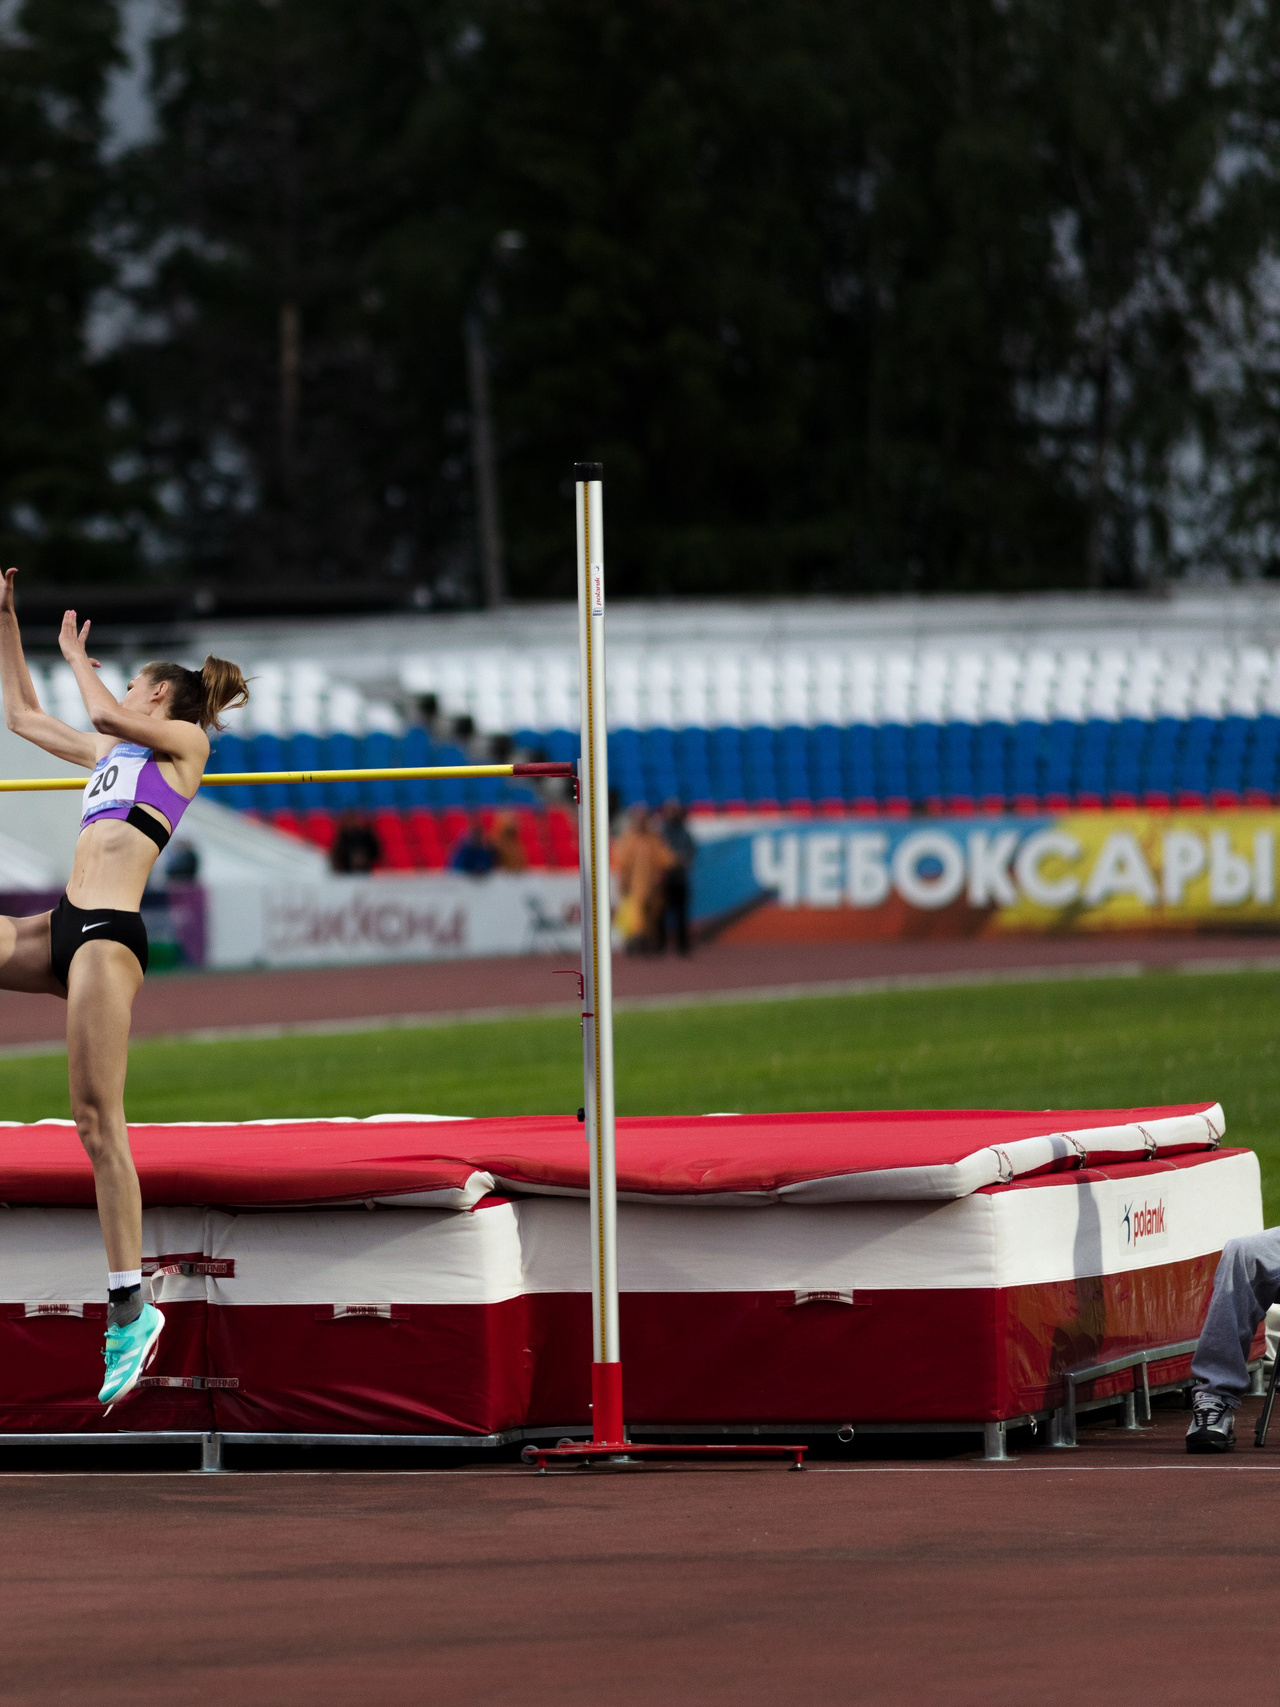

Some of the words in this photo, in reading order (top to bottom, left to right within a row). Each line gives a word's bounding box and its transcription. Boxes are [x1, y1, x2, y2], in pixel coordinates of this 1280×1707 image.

[88, 765, 119, 799] 20
[751, 828, 1276, 908] ЧЕБОКСАРЫ
[1133, 1197, 1165, 1248] polanik
